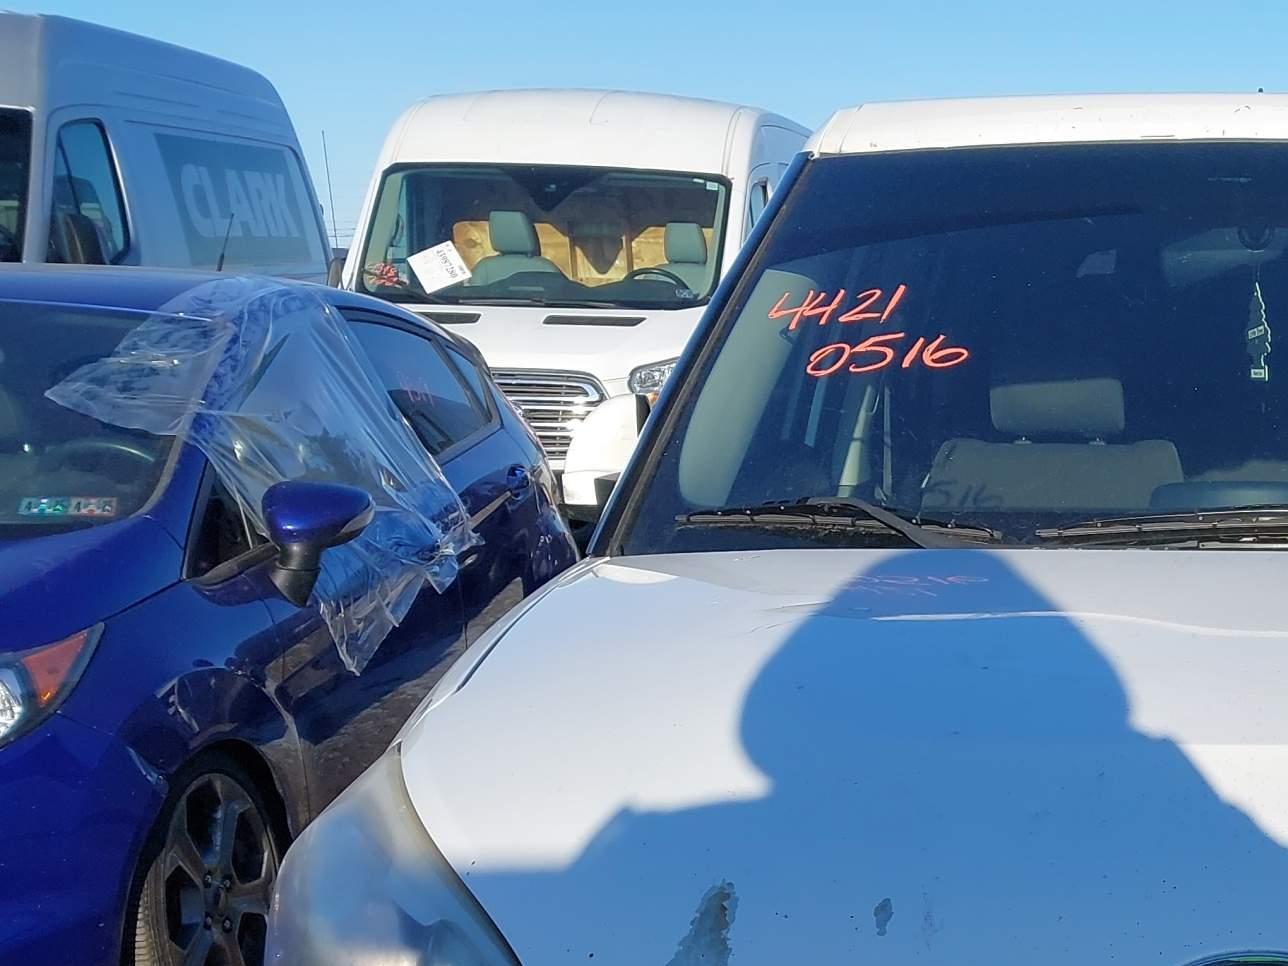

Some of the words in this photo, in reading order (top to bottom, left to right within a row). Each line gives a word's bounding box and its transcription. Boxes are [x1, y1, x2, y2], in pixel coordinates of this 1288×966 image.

[180, 163, 300, 238] CLARK
[767, 284, 907, 331] 4421
[806, 332, 969, 377] 0516
